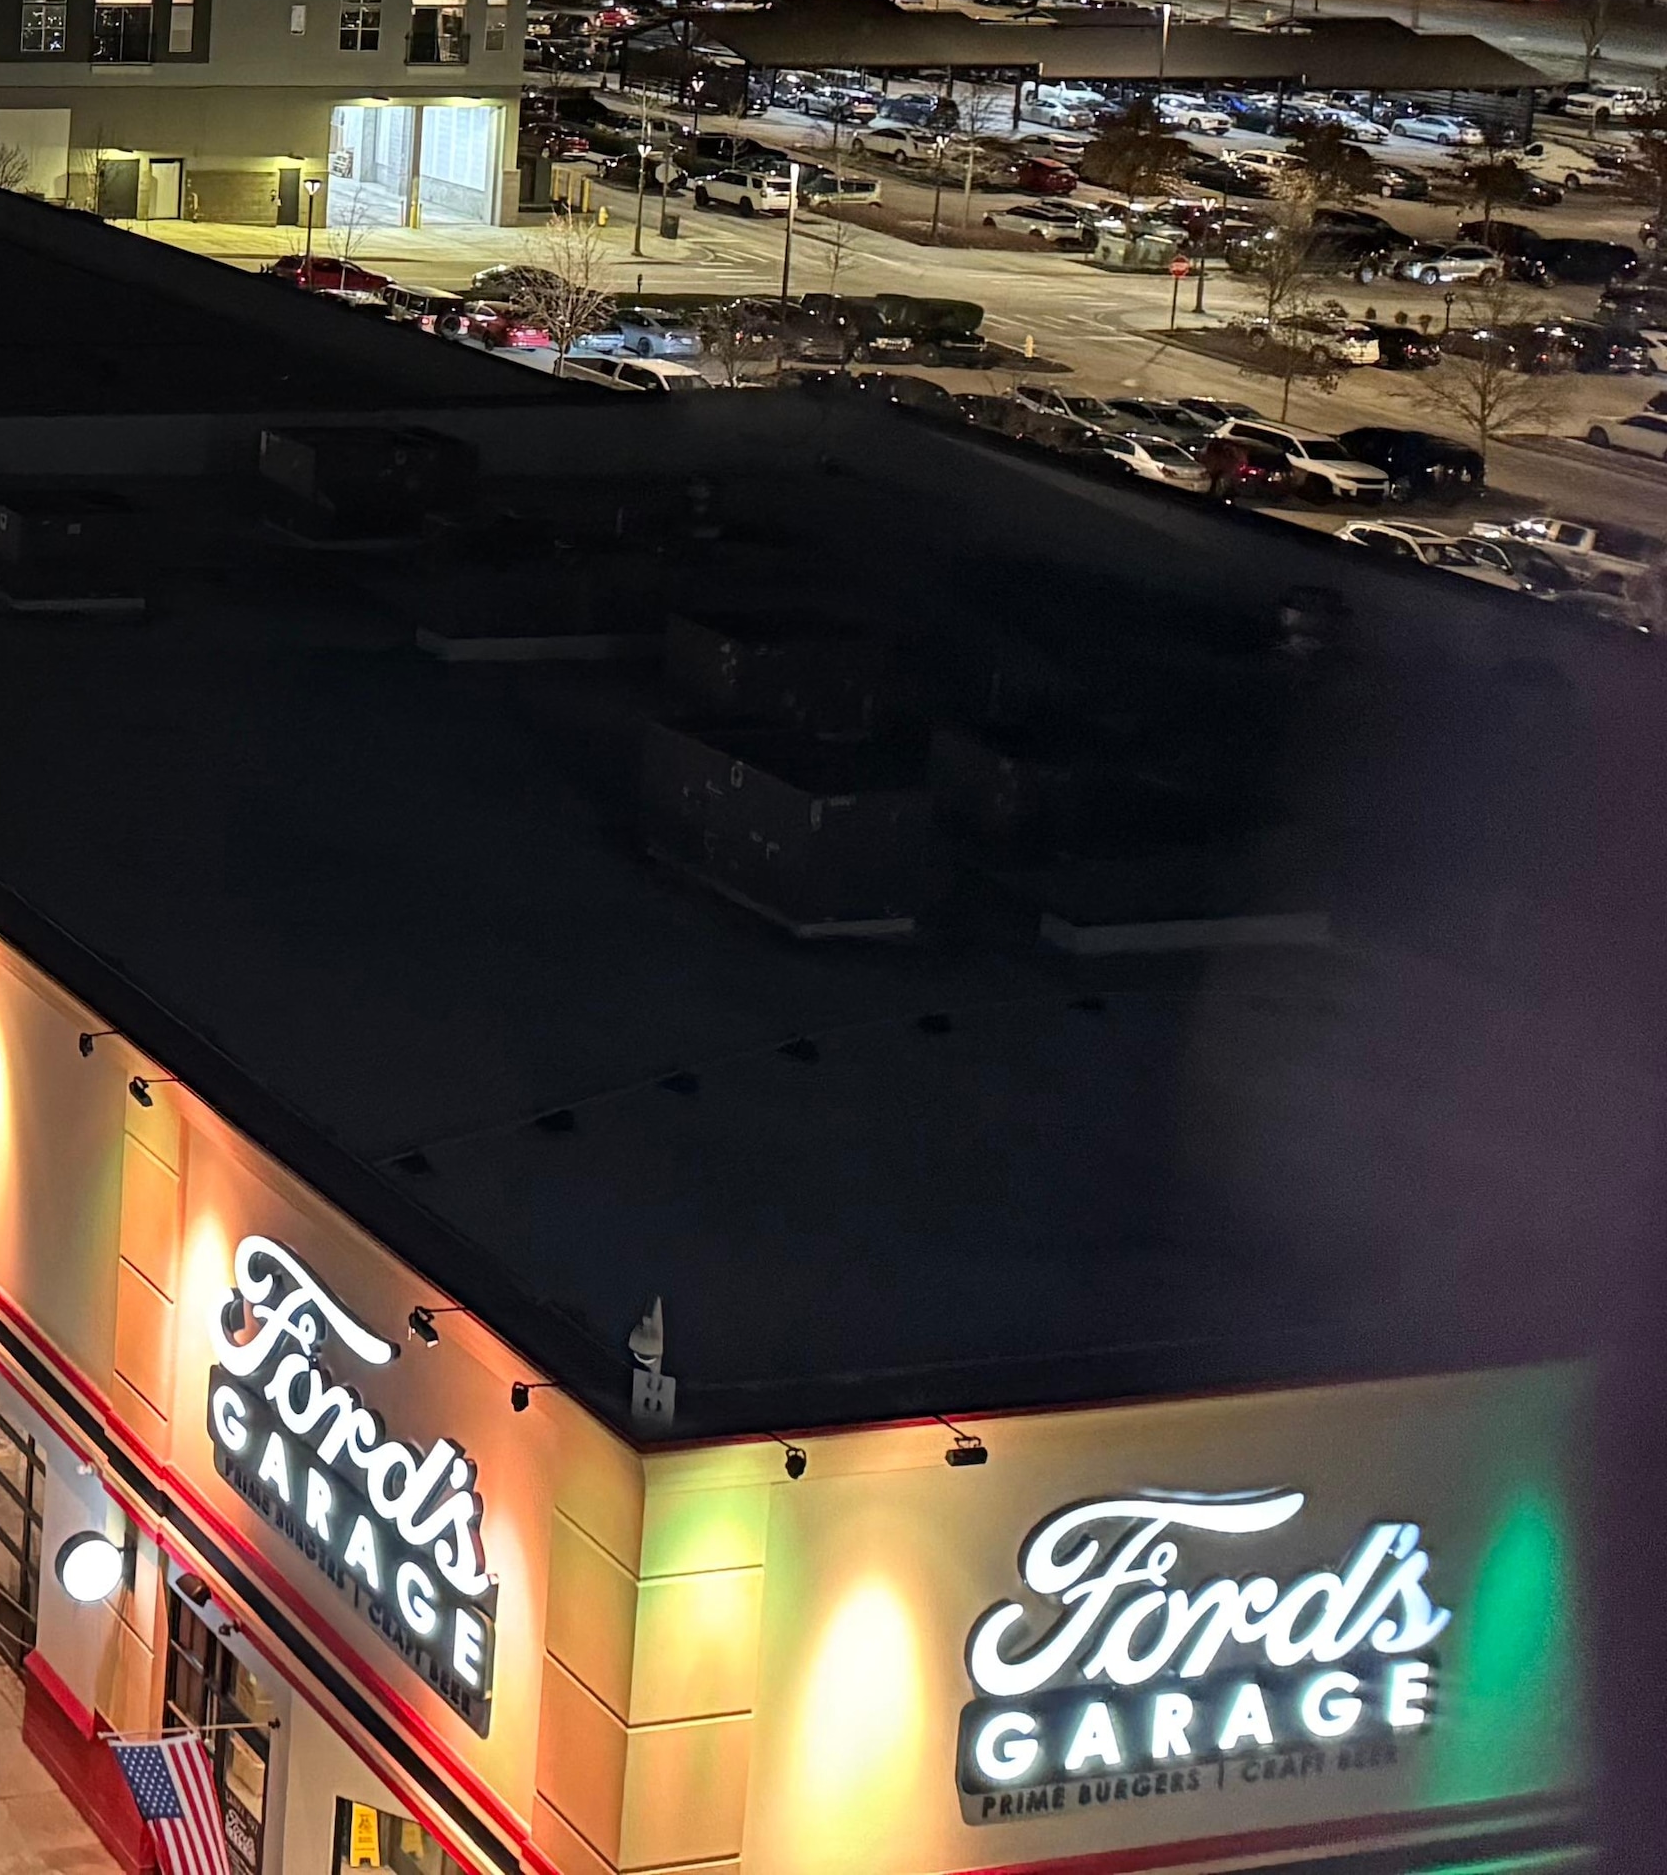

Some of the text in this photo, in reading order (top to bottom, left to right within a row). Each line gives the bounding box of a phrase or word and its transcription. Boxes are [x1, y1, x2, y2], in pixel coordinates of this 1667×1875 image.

[209, 1234, 499, 1598] Ford's
[211, 1382, 484, 1689] GARAGE
[969, 1489, 1452, 1697] Ford's
[973, 1660, 1431, 1782] GARAGE
[981, 1783, 1066, 1818] PRIME
[1077, 1766, 1202, 1807] BURGERS
